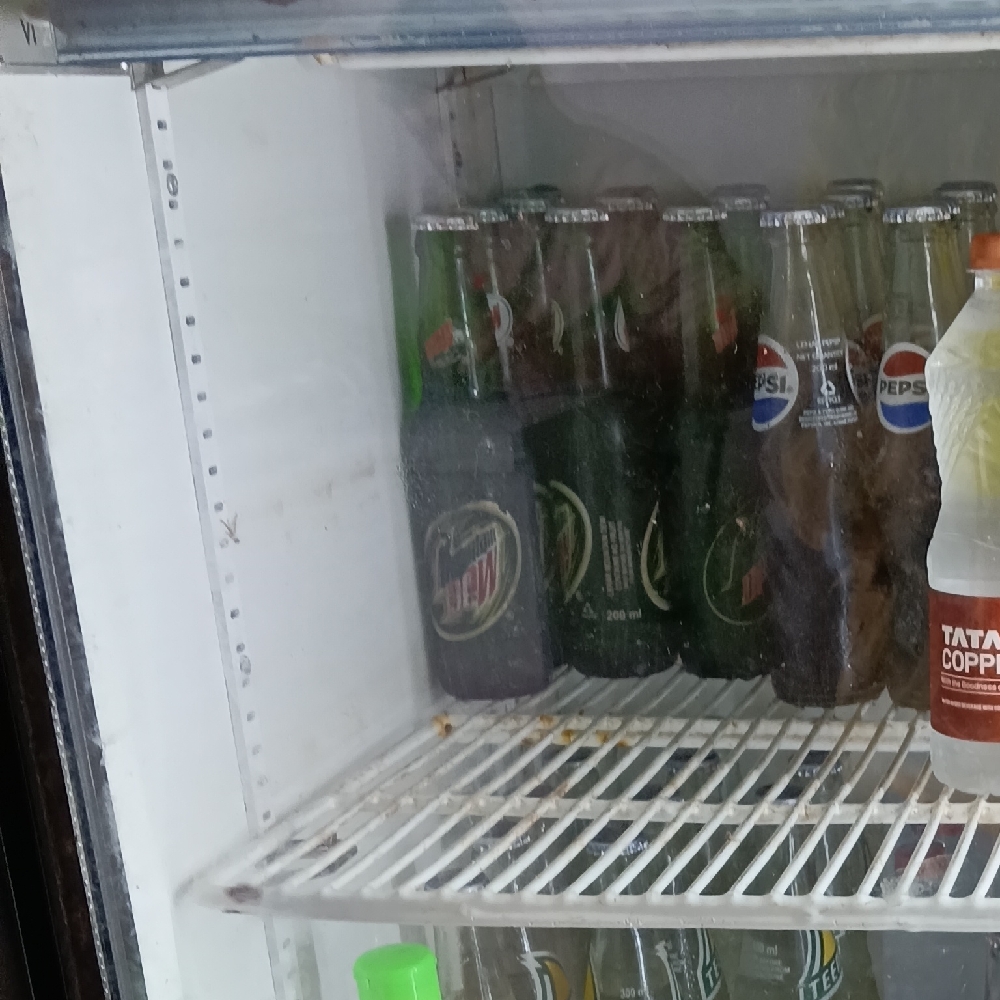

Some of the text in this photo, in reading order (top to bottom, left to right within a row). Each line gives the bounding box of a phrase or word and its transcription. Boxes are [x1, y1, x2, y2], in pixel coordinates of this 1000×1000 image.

[754, 373, 788, 394] PSI
[879, 379, 927, 396] PEPS
[808, 960, 840, 1000] TEE
